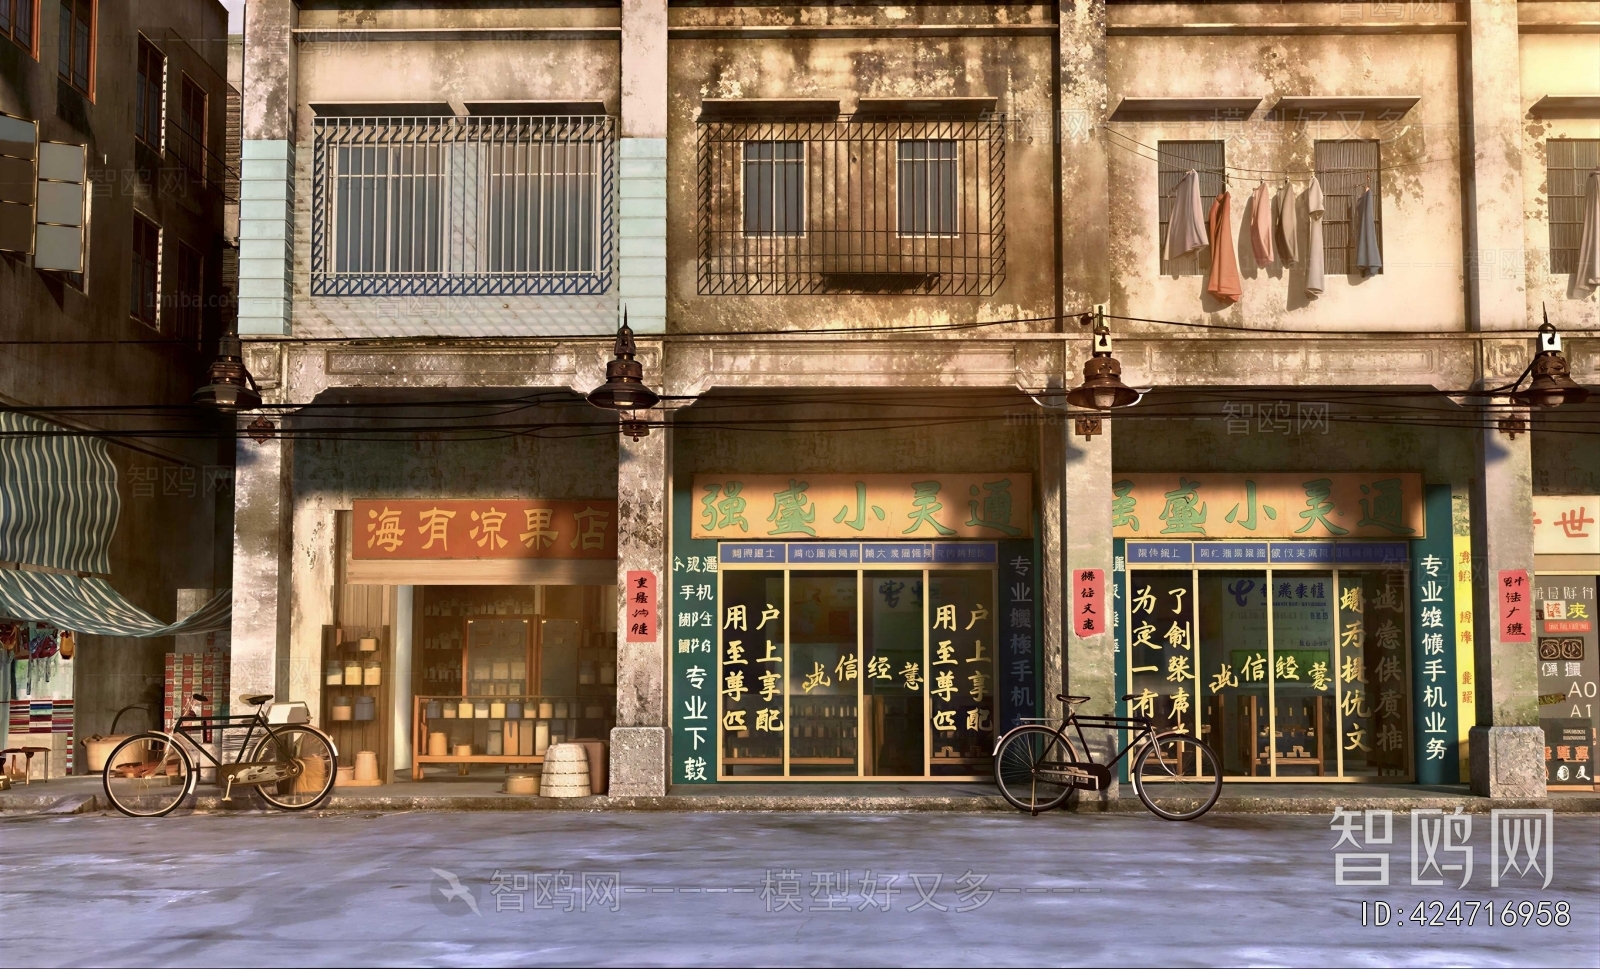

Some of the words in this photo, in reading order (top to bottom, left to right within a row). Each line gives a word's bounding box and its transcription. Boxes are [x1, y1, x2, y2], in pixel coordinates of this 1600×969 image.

[367, 505, 610, 553] 海有凉果店
